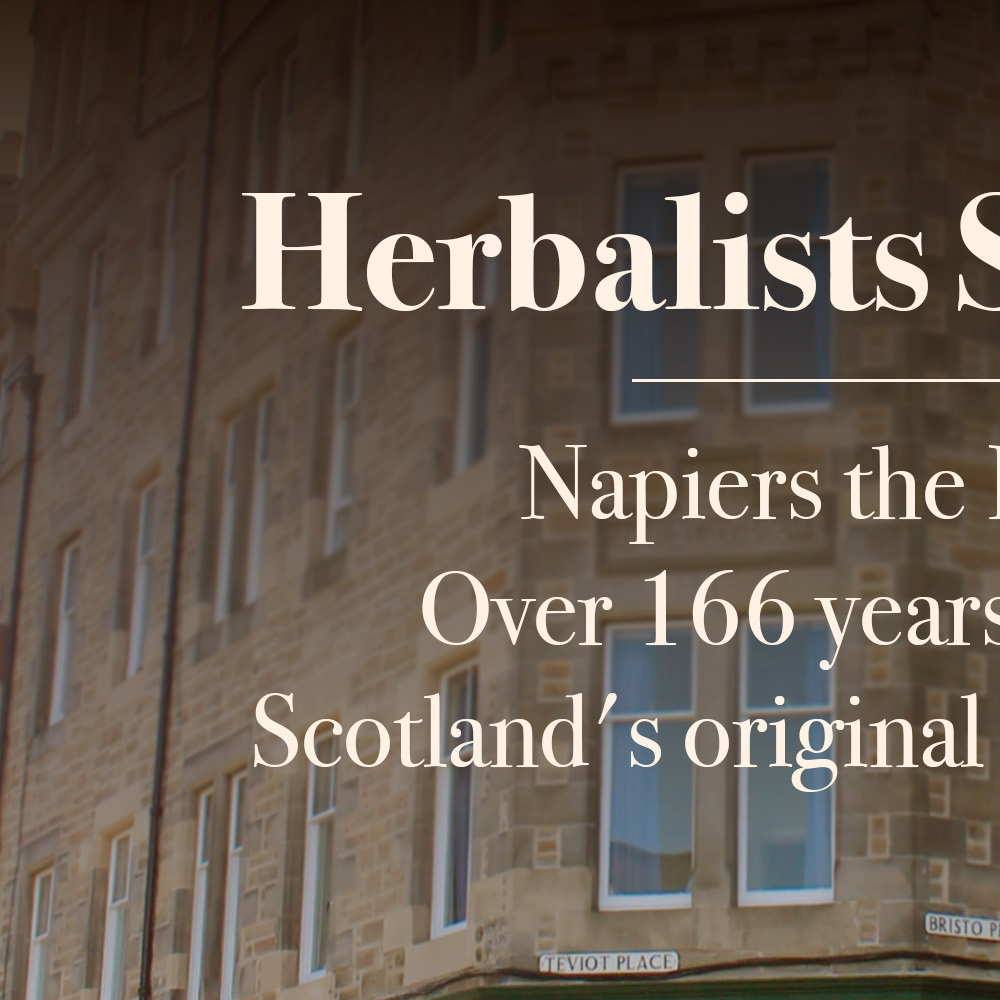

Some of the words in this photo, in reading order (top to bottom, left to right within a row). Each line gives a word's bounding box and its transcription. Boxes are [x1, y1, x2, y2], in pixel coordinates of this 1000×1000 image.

[928, 916, 983, 936] BRISTO
[545, 955, 610, 972] TEVIOT
[616, 954, 673, 971] PLACE
